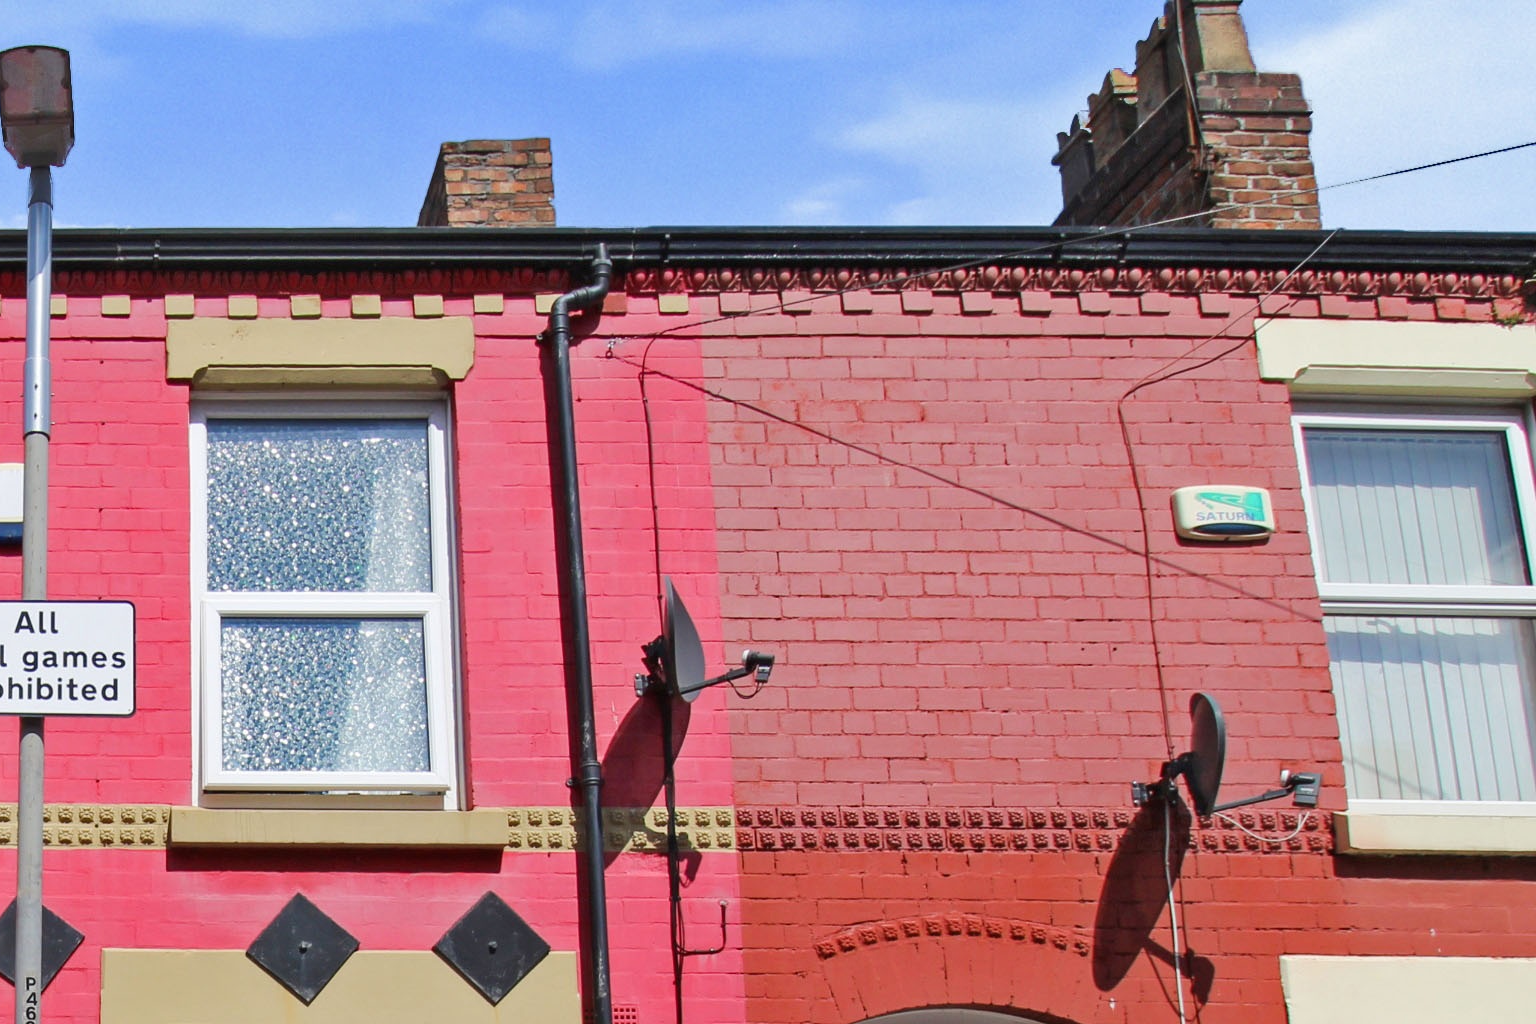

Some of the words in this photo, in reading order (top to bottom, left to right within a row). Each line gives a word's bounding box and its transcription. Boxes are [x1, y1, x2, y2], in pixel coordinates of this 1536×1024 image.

[1196, 512, 1255, 521] SATURN
[14, 611, 59, 634] All
[22, 650, 126, 672] games
